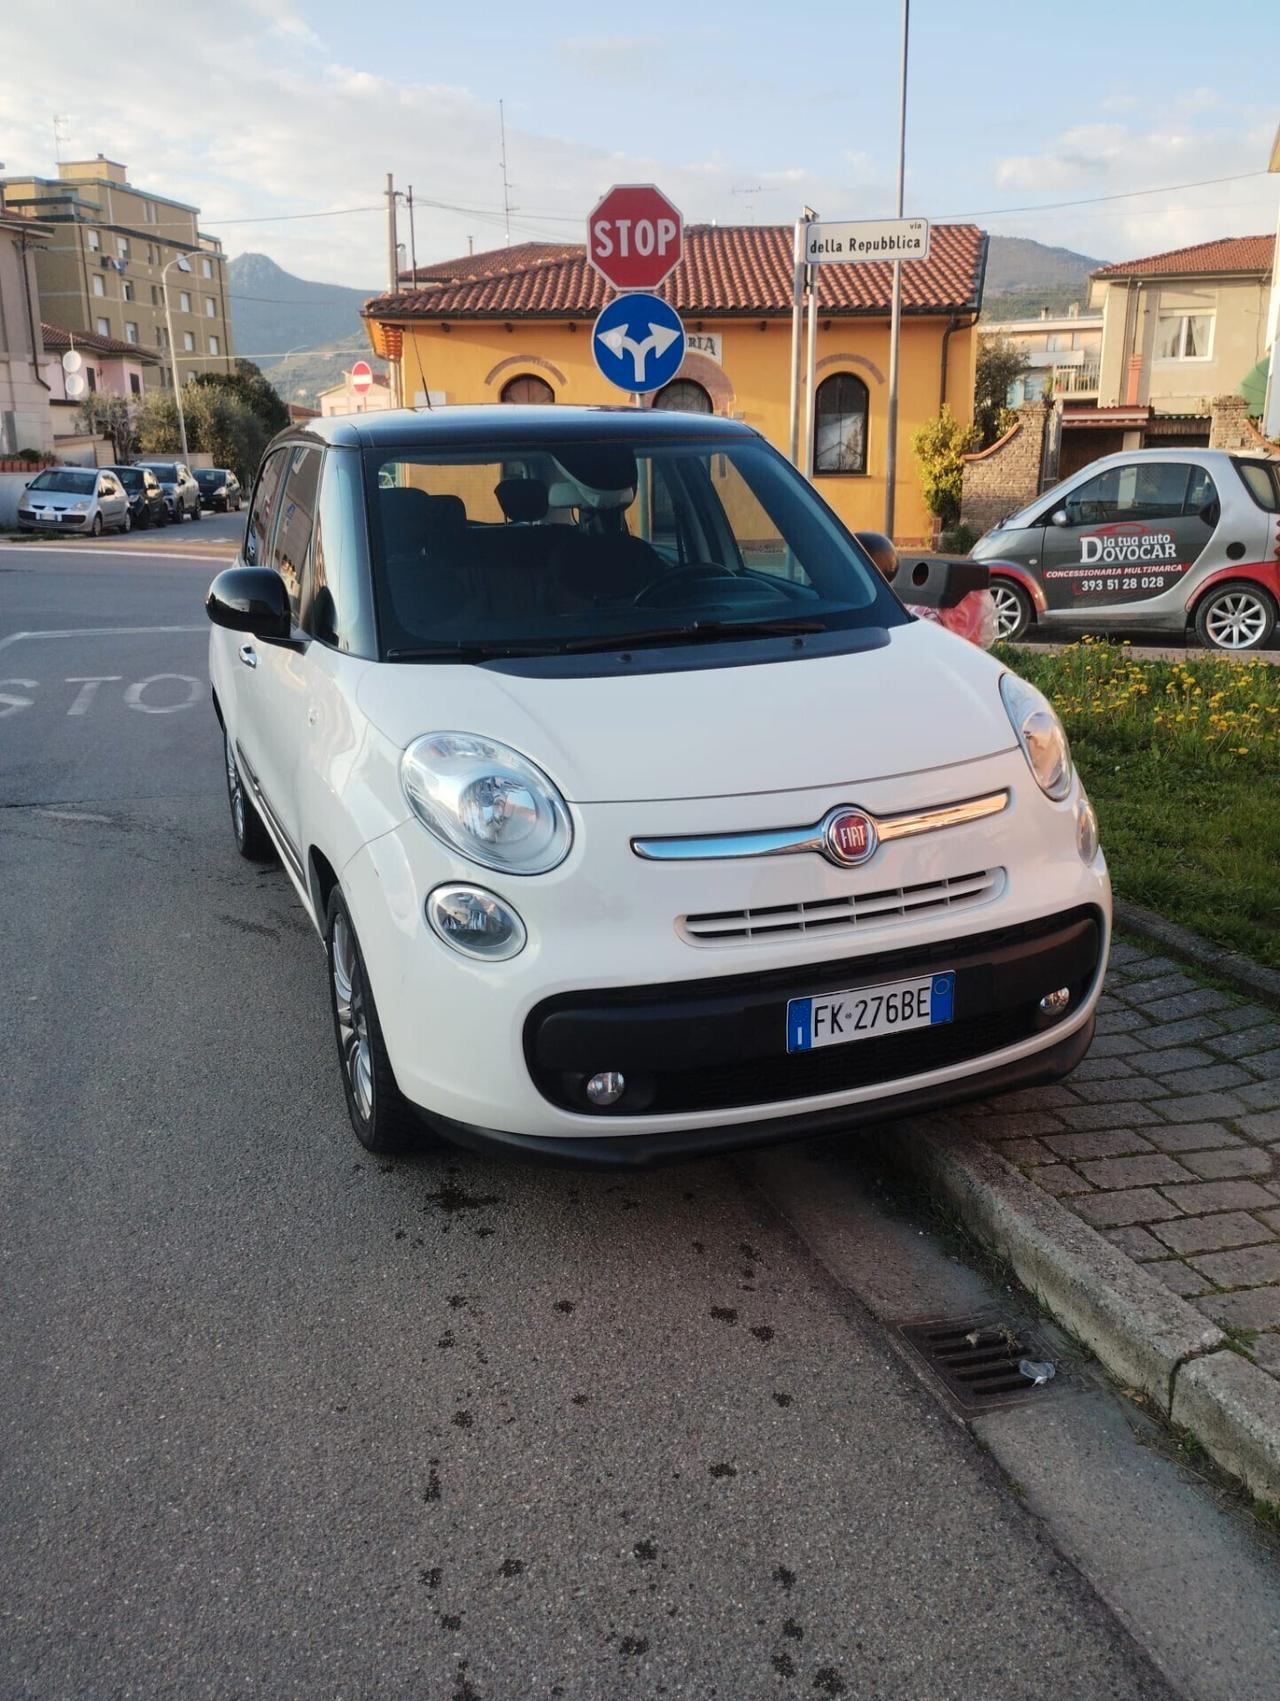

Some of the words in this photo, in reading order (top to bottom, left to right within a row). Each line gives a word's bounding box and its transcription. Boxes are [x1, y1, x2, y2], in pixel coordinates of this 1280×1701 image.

[594, 219, 677, 258] STOP
[810, 239, 842, 254] della
[849, 235, 921, 254] Repubblica
[1080, 536, 1176, 563] DOVOCAR
[1103, 536, 1115, 548] la
[1118, 535, 1138, 547] tua
[1141, 533, 1171, 546] auto
[1046, 568, 1122, 579] CONCESSIONARIA
[1124, 564, 1183, 575] MULTIMARCA
[1081, 580, 1103, 592] 393
[1107, 579, 1119, 591] 51
[1123, 578, 1138, 590] 28
[1141, 576, 1165, 589] 028
[840, 824, 867, 849] FIAT
